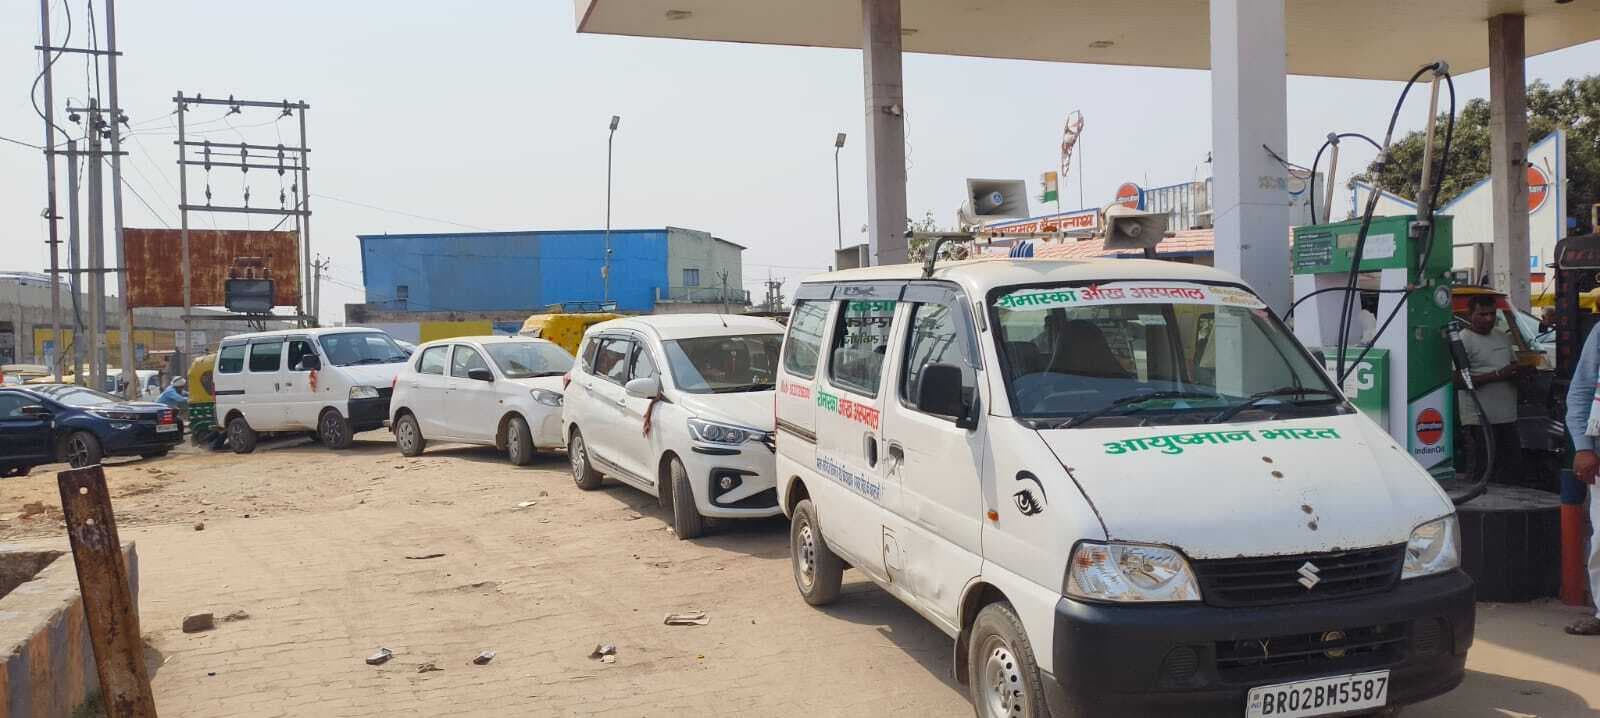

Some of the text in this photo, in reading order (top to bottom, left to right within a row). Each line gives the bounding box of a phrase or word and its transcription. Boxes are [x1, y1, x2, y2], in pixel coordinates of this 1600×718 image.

[1129, 287, 1205, 300] अस्पताल
[1103, 427, 1342, 455] आयुष्मान भारत
[1414, 446, 1445, 456] IndianOil
[1262, 677, 1387, 715] BR02BM5587
